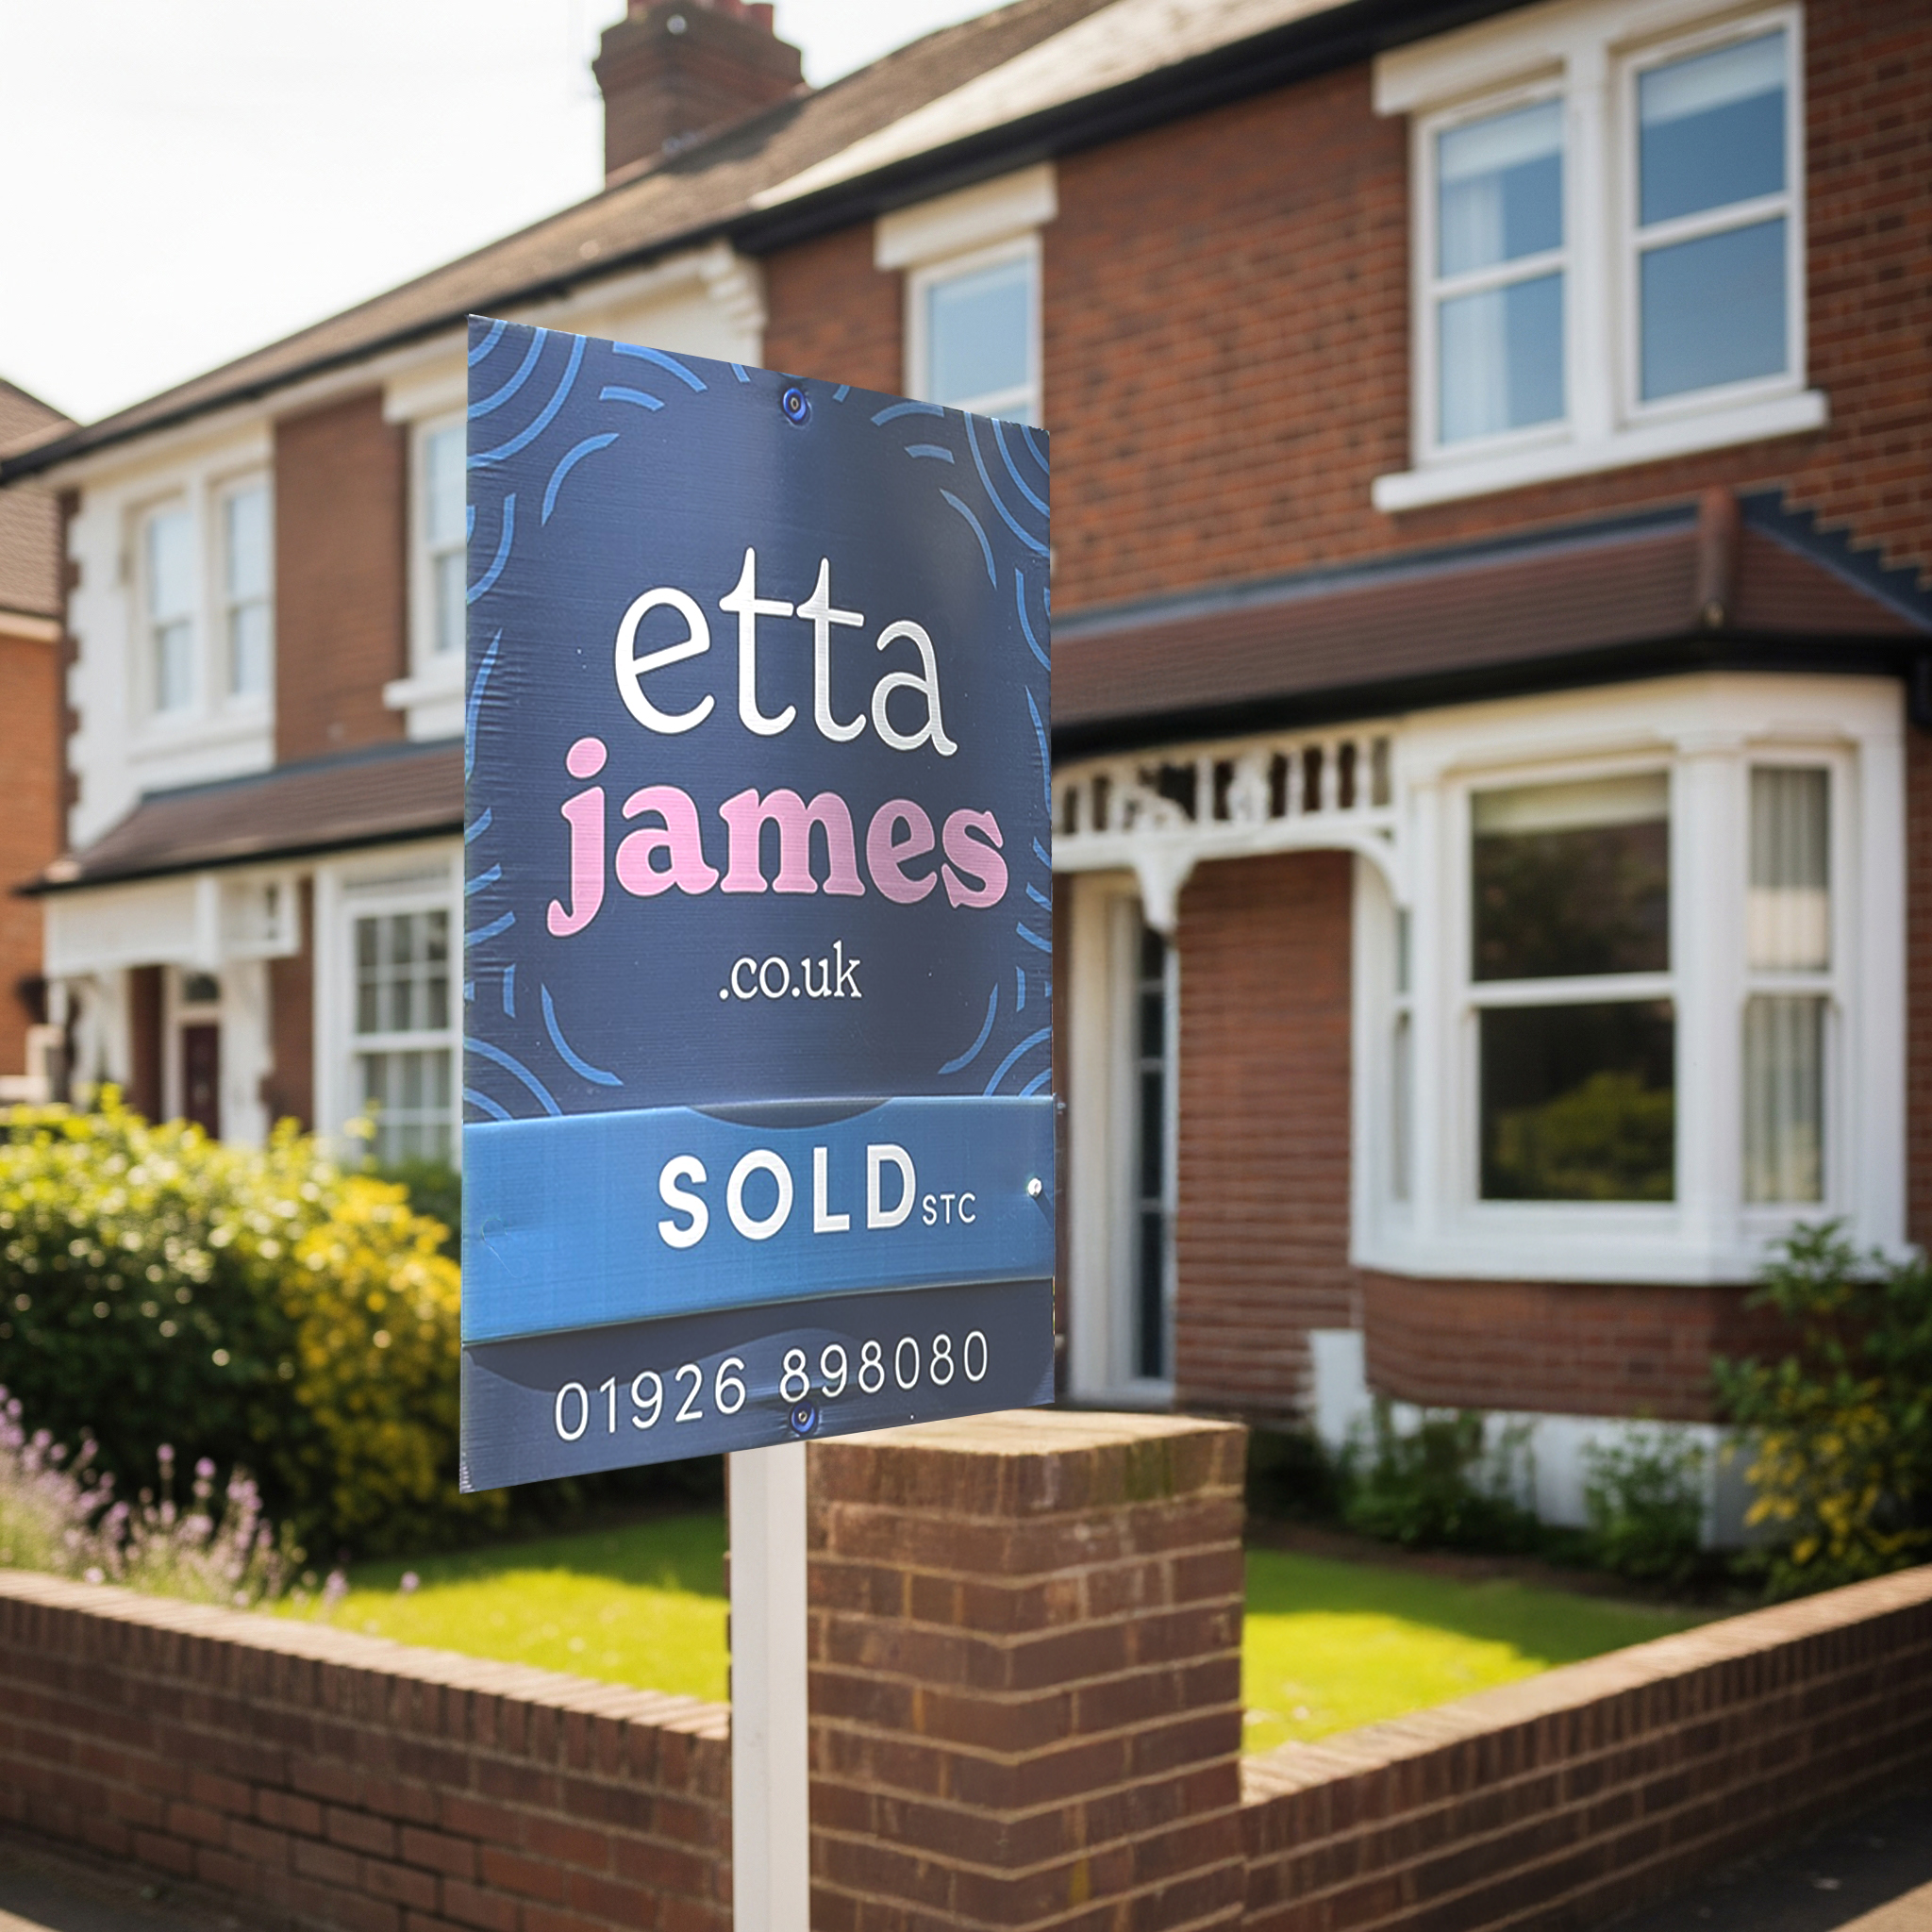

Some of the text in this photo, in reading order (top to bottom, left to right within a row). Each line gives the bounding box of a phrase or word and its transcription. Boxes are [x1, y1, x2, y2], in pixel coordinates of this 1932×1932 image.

[614, 546, 958, 757] etta
[546, 737, 1009, 937] james
[718, 940, 862, 1000] .co.uk
[658, 1143, 976, 1249] SOLD STC
[555, 1331, 989, 1441] 01926 898080
